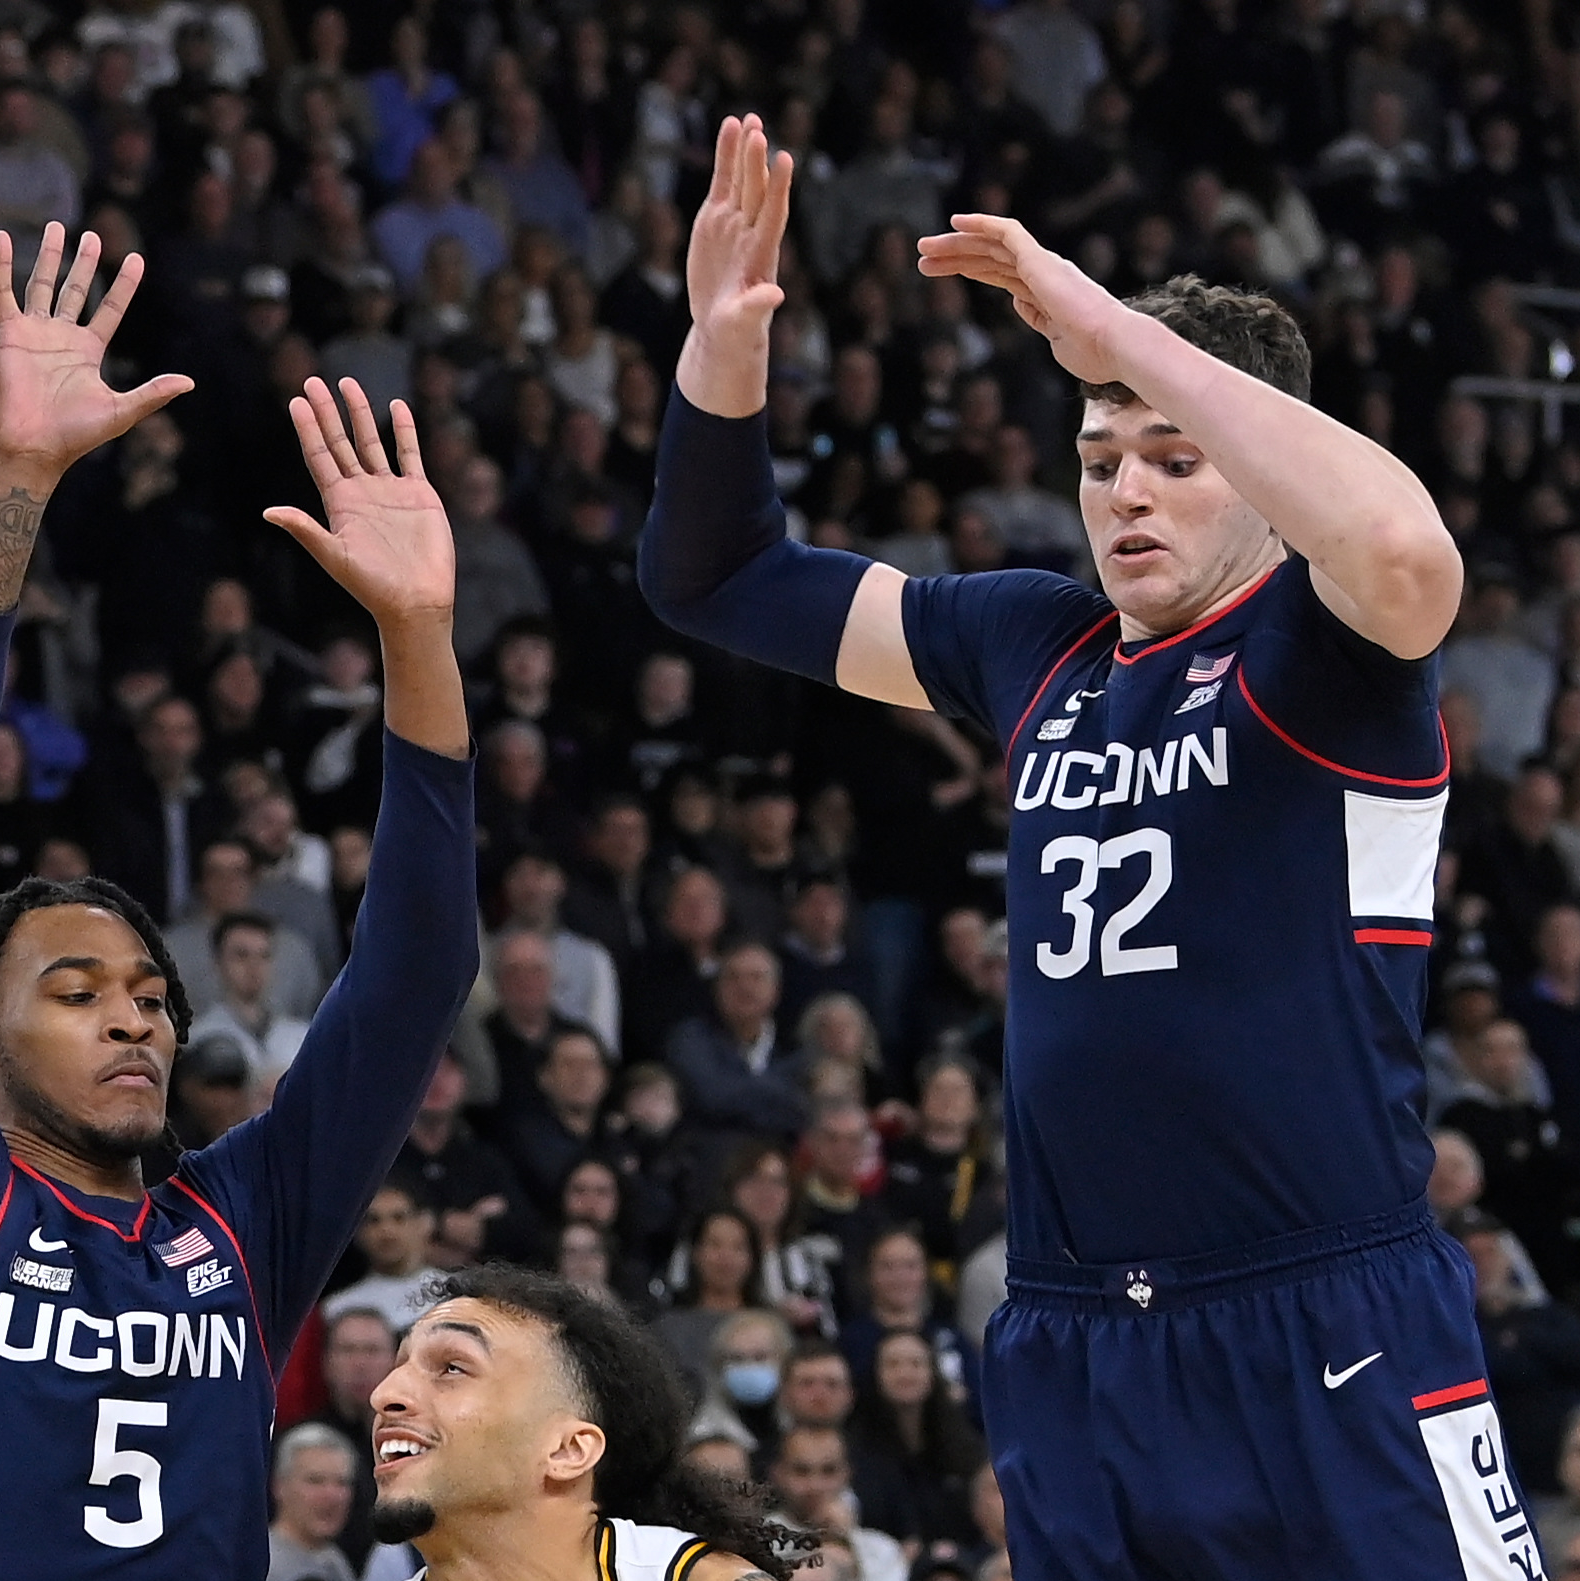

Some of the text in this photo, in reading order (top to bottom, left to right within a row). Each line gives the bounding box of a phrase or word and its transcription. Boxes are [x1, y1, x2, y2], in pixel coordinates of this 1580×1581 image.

[1014, 727, 1230, 812] UCONN
[1036, 827, 1178, 979] 32
[12, 1270, 71, 1292] CHANGE
[23, 1260, 52, 1279] BE
[187, 1258, 218, 1281] BIG
[188, 1265, 233, 1293] EAST
[84, 1398, 168, 1548] 5
